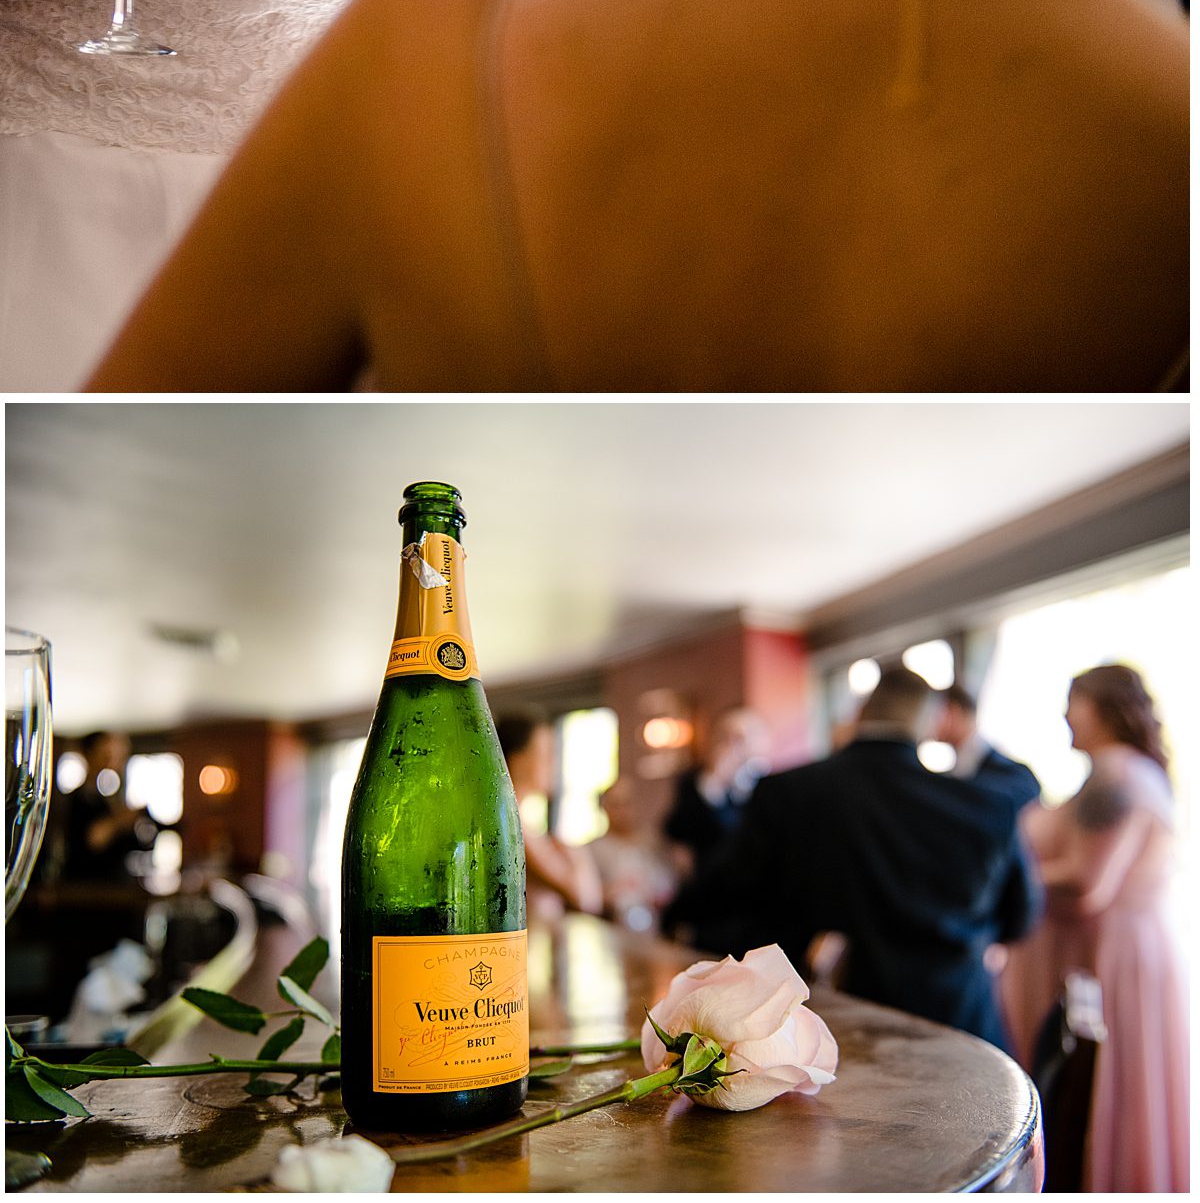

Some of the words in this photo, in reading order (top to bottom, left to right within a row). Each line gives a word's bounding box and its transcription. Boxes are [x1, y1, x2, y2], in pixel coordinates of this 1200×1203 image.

[443, 586, 453, 614] Veuve
[423, 946, 521, 970] CHAMPAGNE
[413, 1001, 469, 1023] Veuve
[474, 997, 524, 1019] Clicquot
[467, 1036, 496, 1048] BRUT
[454, 1058, 482, 1066] REIMS
[486, 1052, 512, 1062] FRANCE
